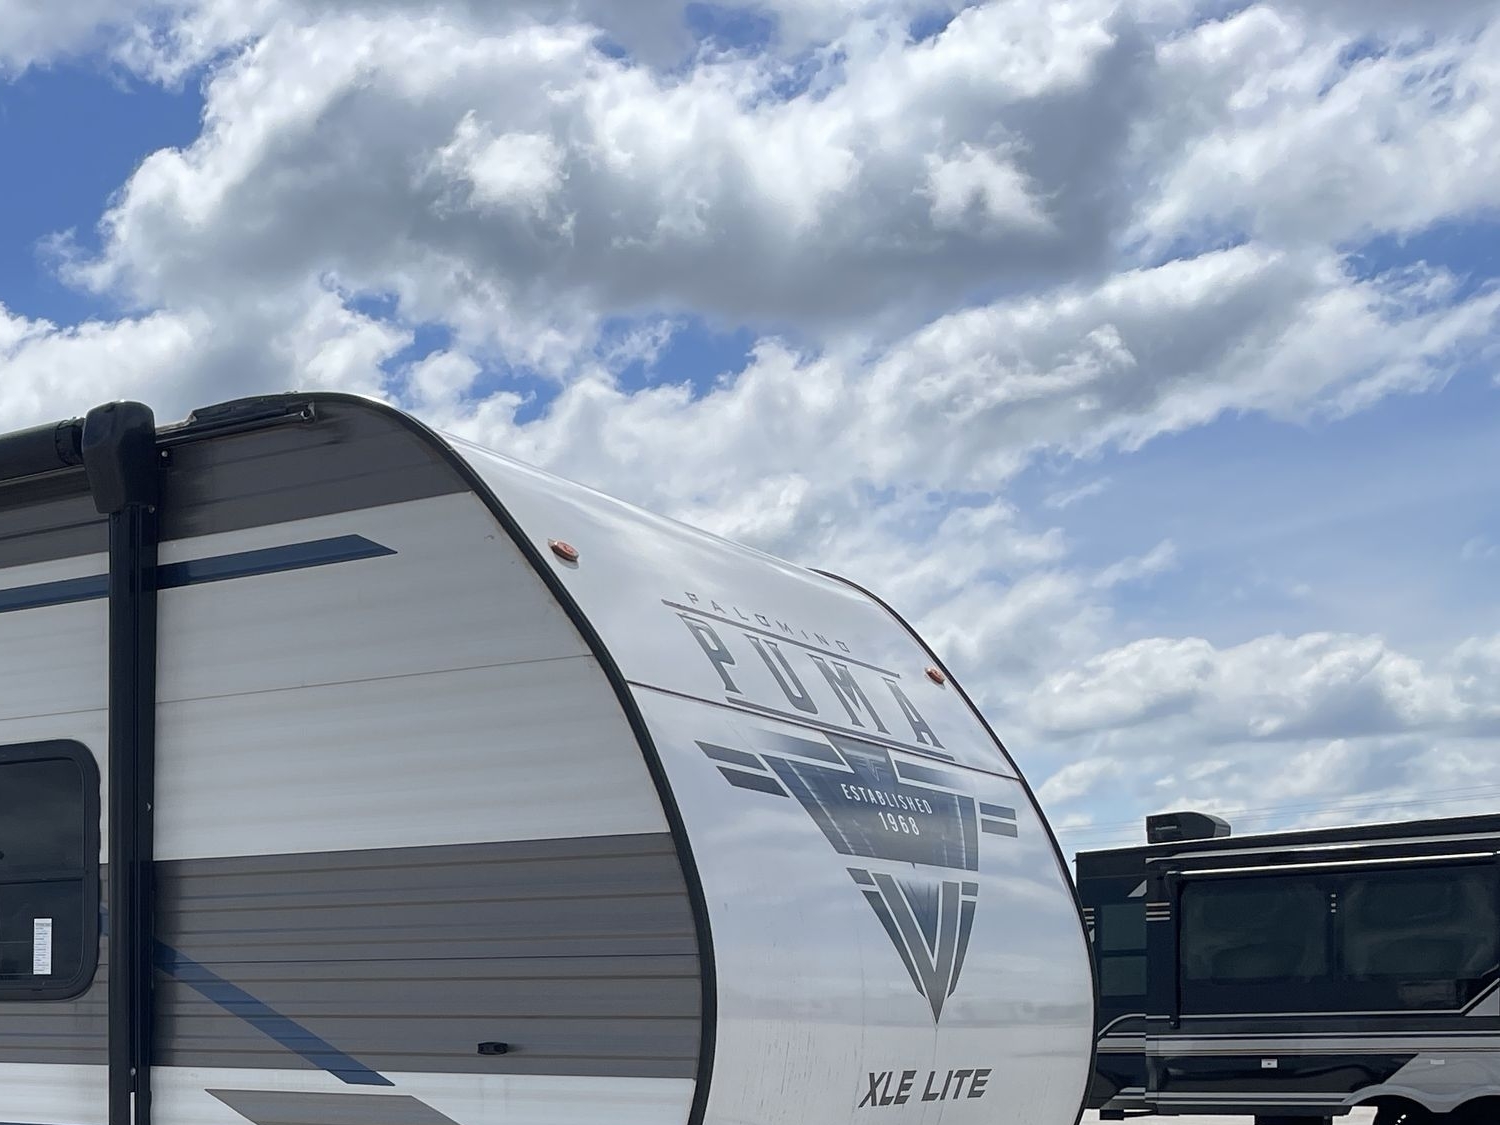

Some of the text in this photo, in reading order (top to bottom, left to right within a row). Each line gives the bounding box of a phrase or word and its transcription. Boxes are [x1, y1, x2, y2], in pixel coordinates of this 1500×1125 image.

[684, 591, 850, 653] PALOMINO
[676, 612, 946, 750] PUMA
[840, 783, 933, 815] ESTABLISHED
[878, 811, 920, 836] 1968
[857, 1068, 993, 1109] XLE LITE
